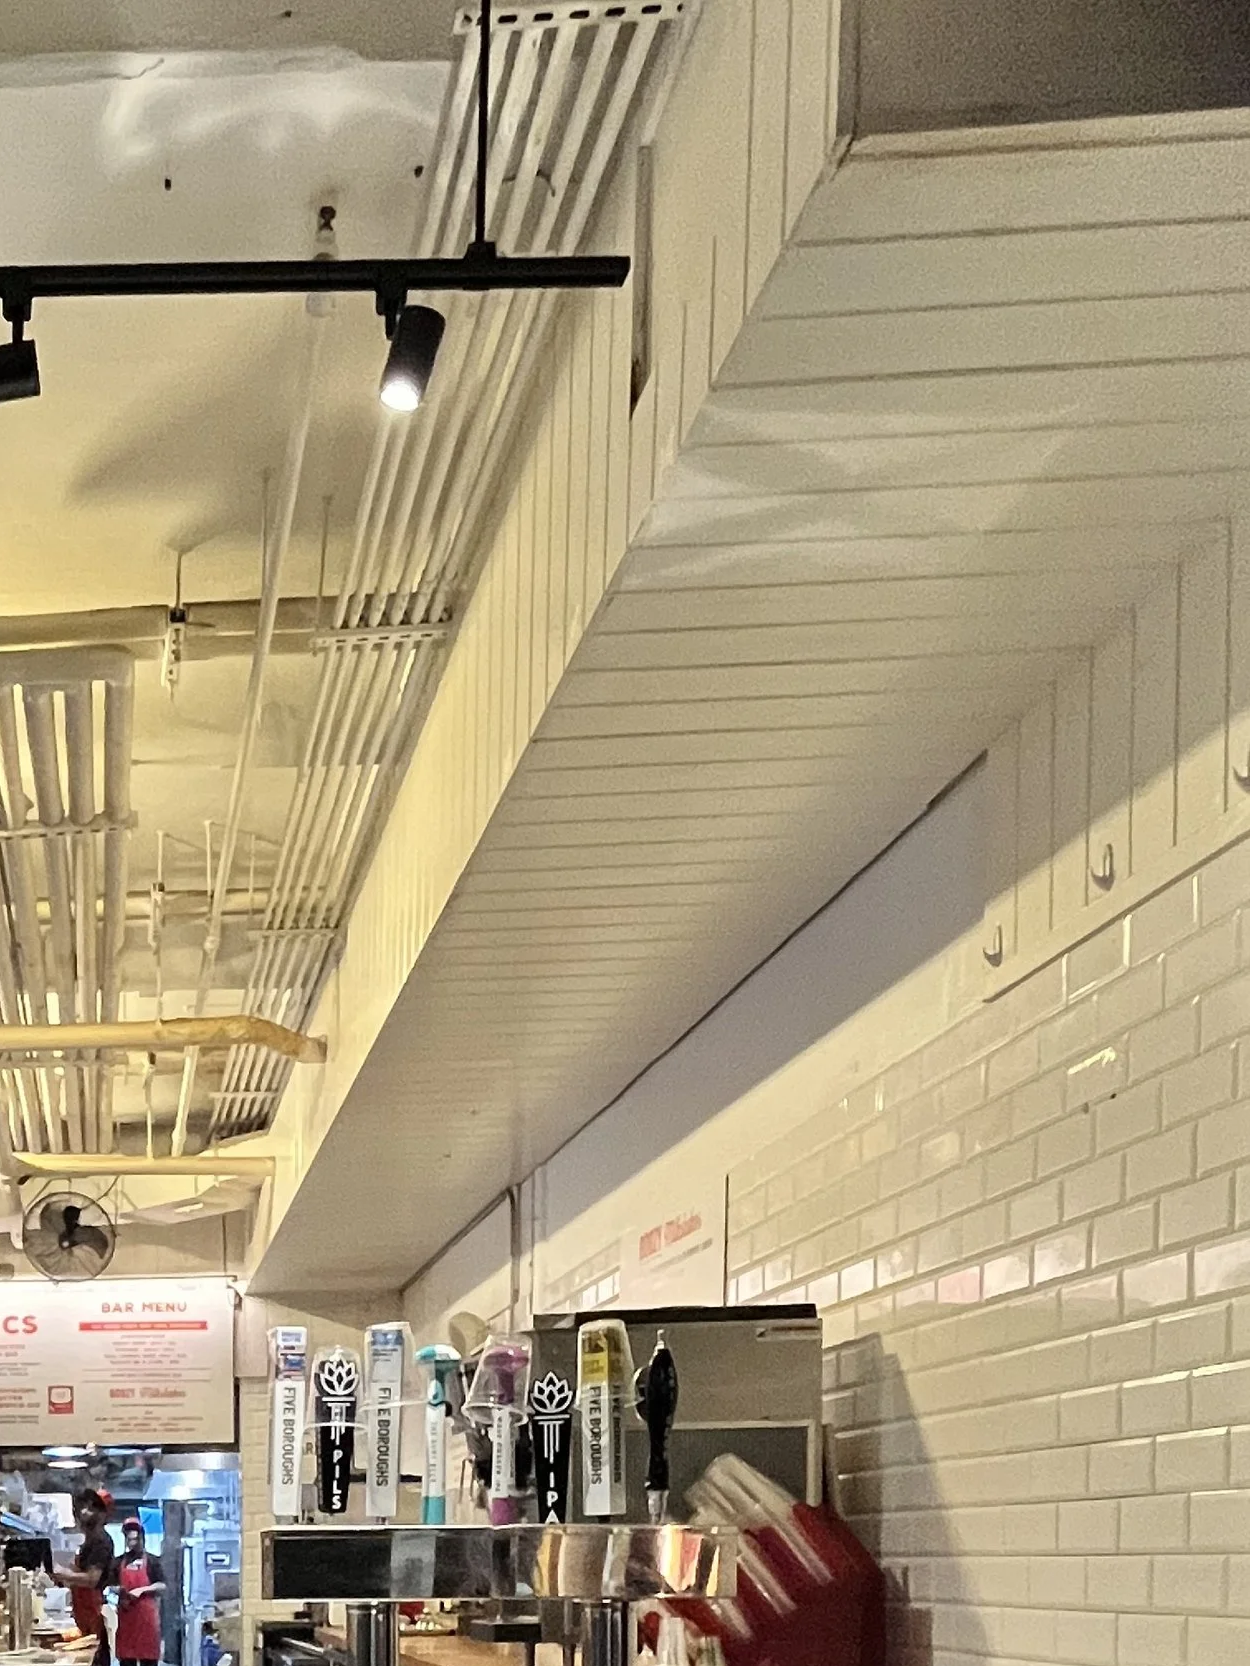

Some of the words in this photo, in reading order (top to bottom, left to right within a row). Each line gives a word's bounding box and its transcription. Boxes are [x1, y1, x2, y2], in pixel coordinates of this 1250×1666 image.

[101, 1302, 134, 1313] BAR
[142, 1302, 187, 1313] MENU
[284, 1387, 295, 1416] FIVE
[282, 1418, 295, 1485] BOROUGHS
[332, 1449, 343, 1510] PILS
[376, 1418, 390, 1487] BOROUGHS
[591, 1418, 602, 1485] BOROUGHS
[545, 1471, 559, 1524] IPA
